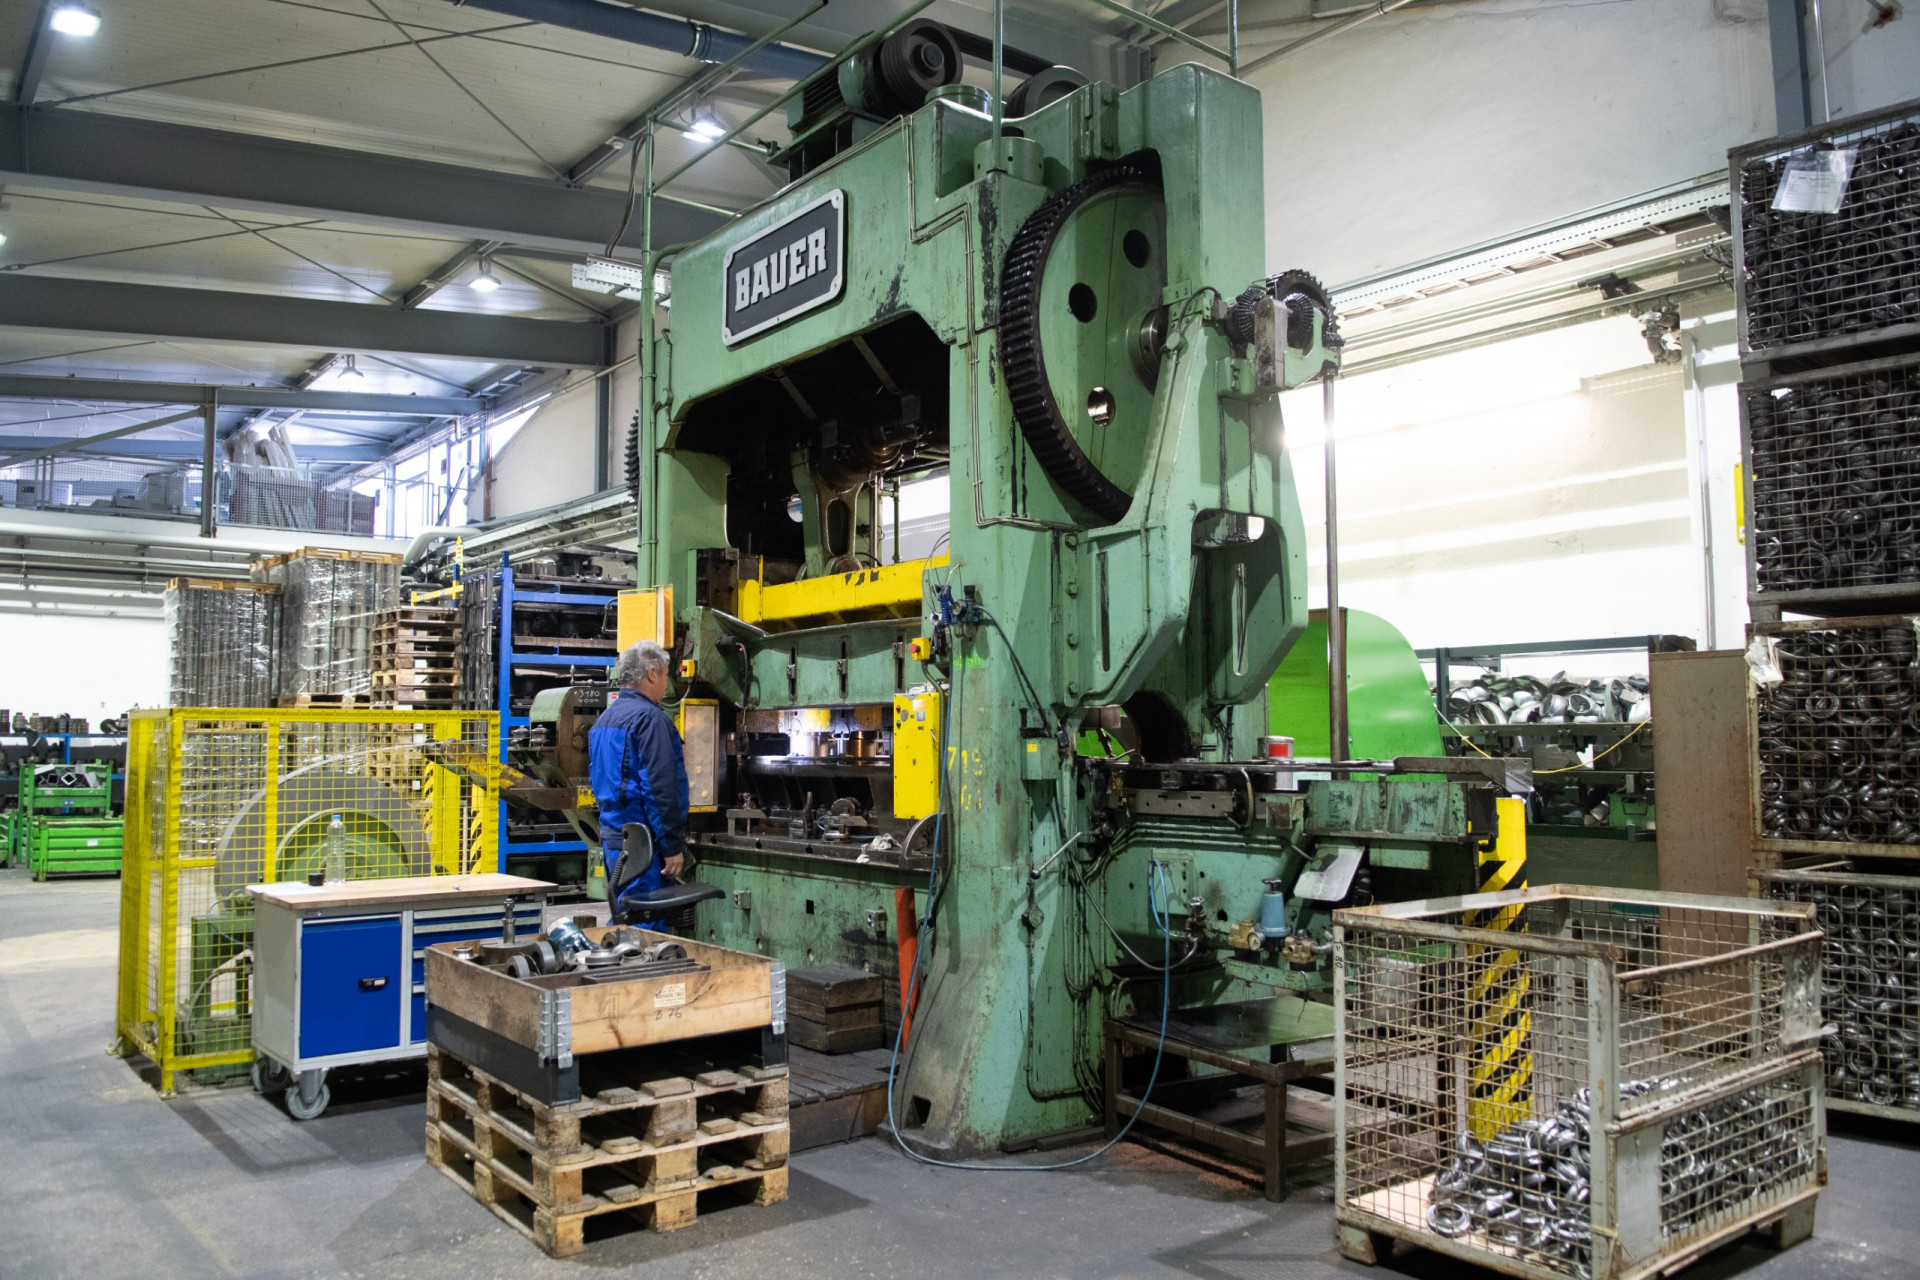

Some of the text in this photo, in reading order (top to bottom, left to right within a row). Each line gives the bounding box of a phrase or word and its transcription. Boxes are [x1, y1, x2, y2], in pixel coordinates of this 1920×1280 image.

[734, 227, 827, 312] BAUER
[655, 1007, 682, 1021] B 76
